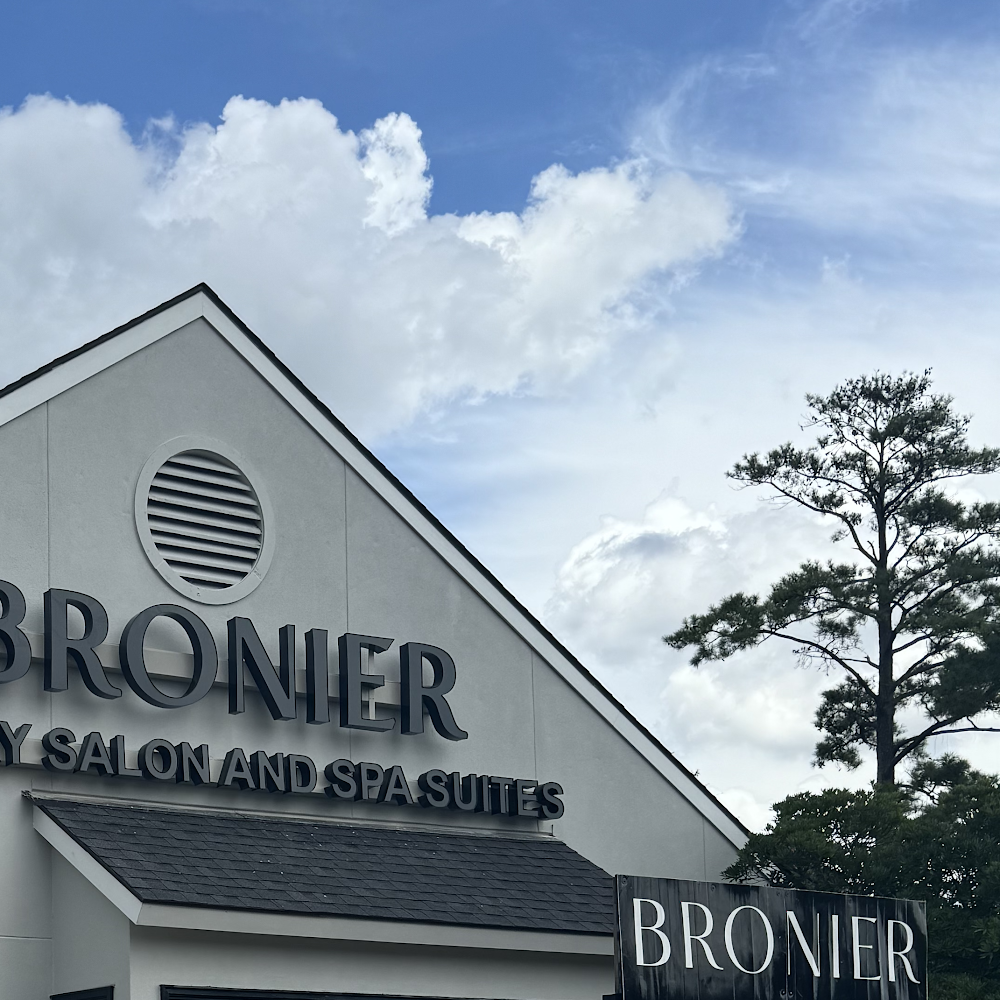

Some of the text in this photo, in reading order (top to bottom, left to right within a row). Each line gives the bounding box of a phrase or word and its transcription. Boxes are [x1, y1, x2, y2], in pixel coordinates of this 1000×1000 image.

[41, 727, 211, 786] SALON
[220, 747, 318, 794] AND
[325, 758, 415, 806] SPA
[417, 768, 565, 820] SUITES
[632, 897, 921, 984] BRONIER
